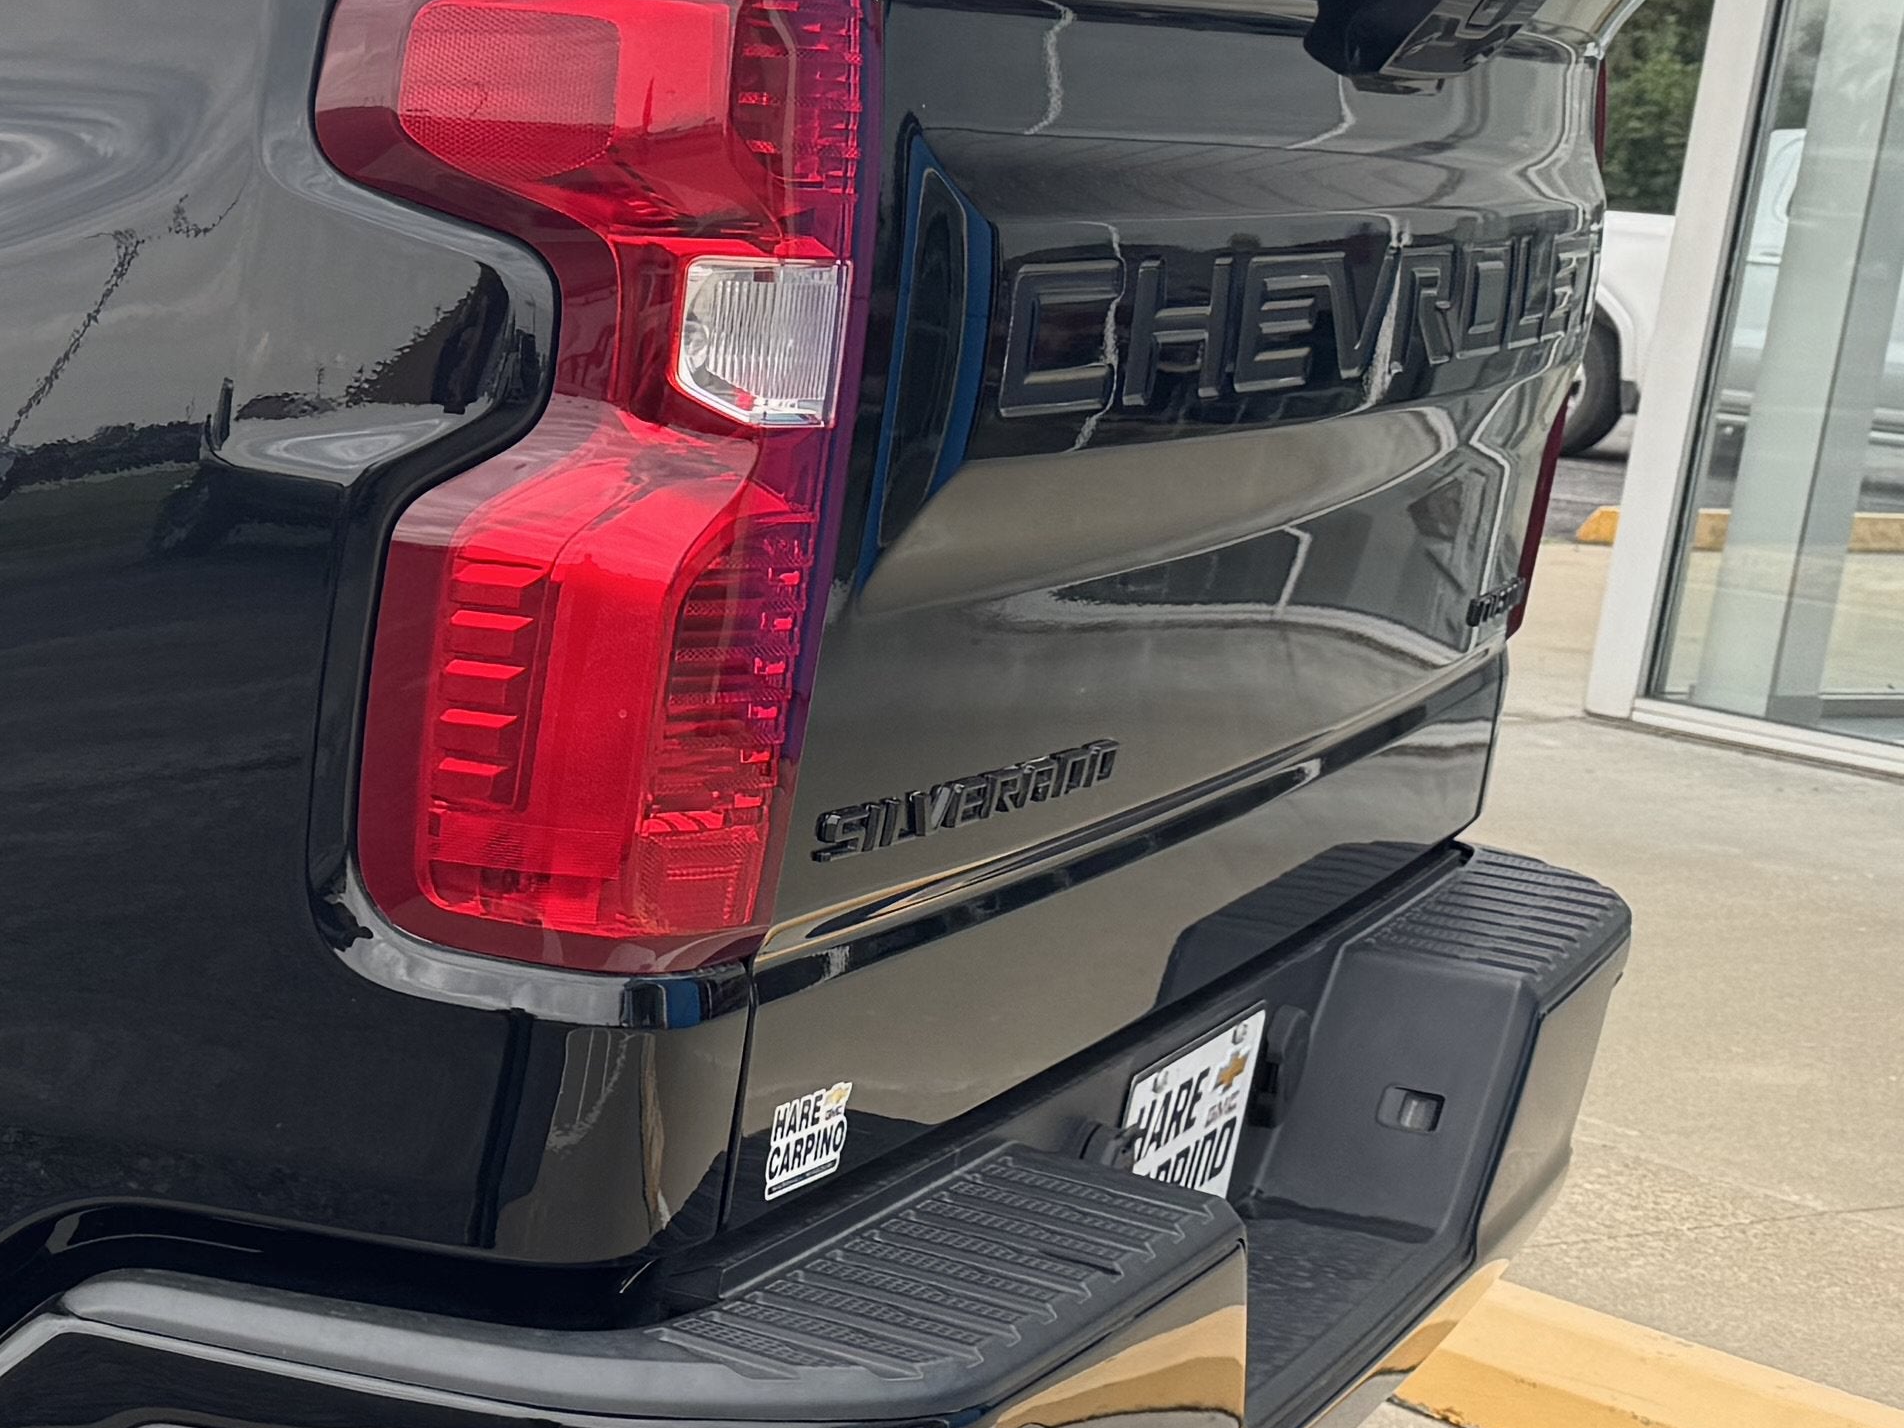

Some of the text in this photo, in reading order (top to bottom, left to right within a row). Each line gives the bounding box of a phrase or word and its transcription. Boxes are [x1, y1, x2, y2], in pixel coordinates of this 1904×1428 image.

[810, 737, 1120, 863] SILVERADO
[768, 1119, 845, 1181] CARPINO
[773, 1093, 824, 1143] HARE
[1134, 1066, 1211, 1163] HARE
